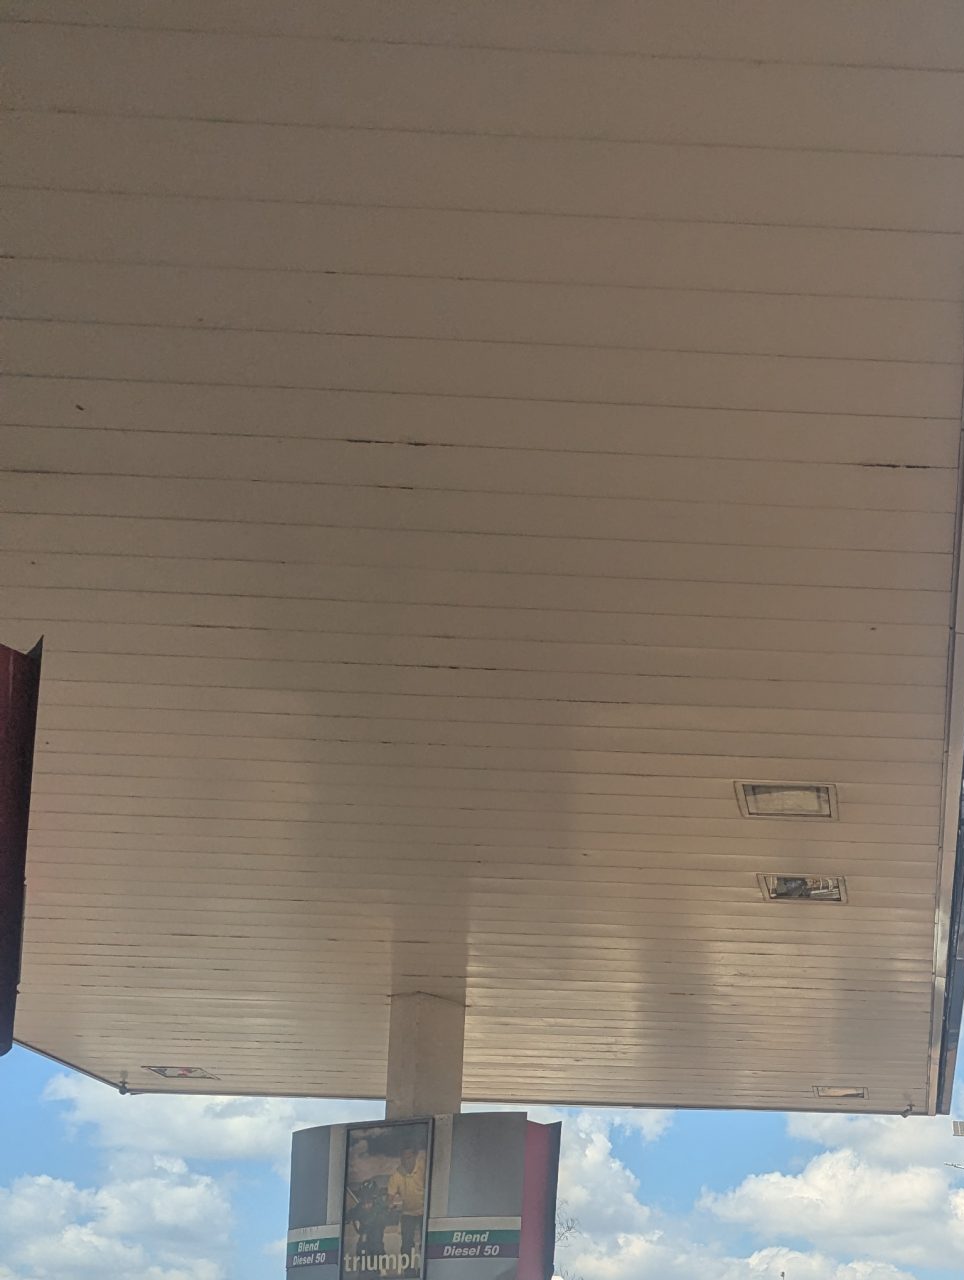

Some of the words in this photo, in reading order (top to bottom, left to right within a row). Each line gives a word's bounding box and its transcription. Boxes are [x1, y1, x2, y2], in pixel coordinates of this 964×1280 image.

[452, 1231, 490, 1243] Blend
[297, 1241, 319, 1252] Blend
[443, 1246, 481, 1257] Diesel
[483, 1245, 500, 1256] 50
[293, 1255, 313, 1266] Diesel
[315, 1253, 326, 1263] 50
[344, 1248, 421, 1275] triumph
